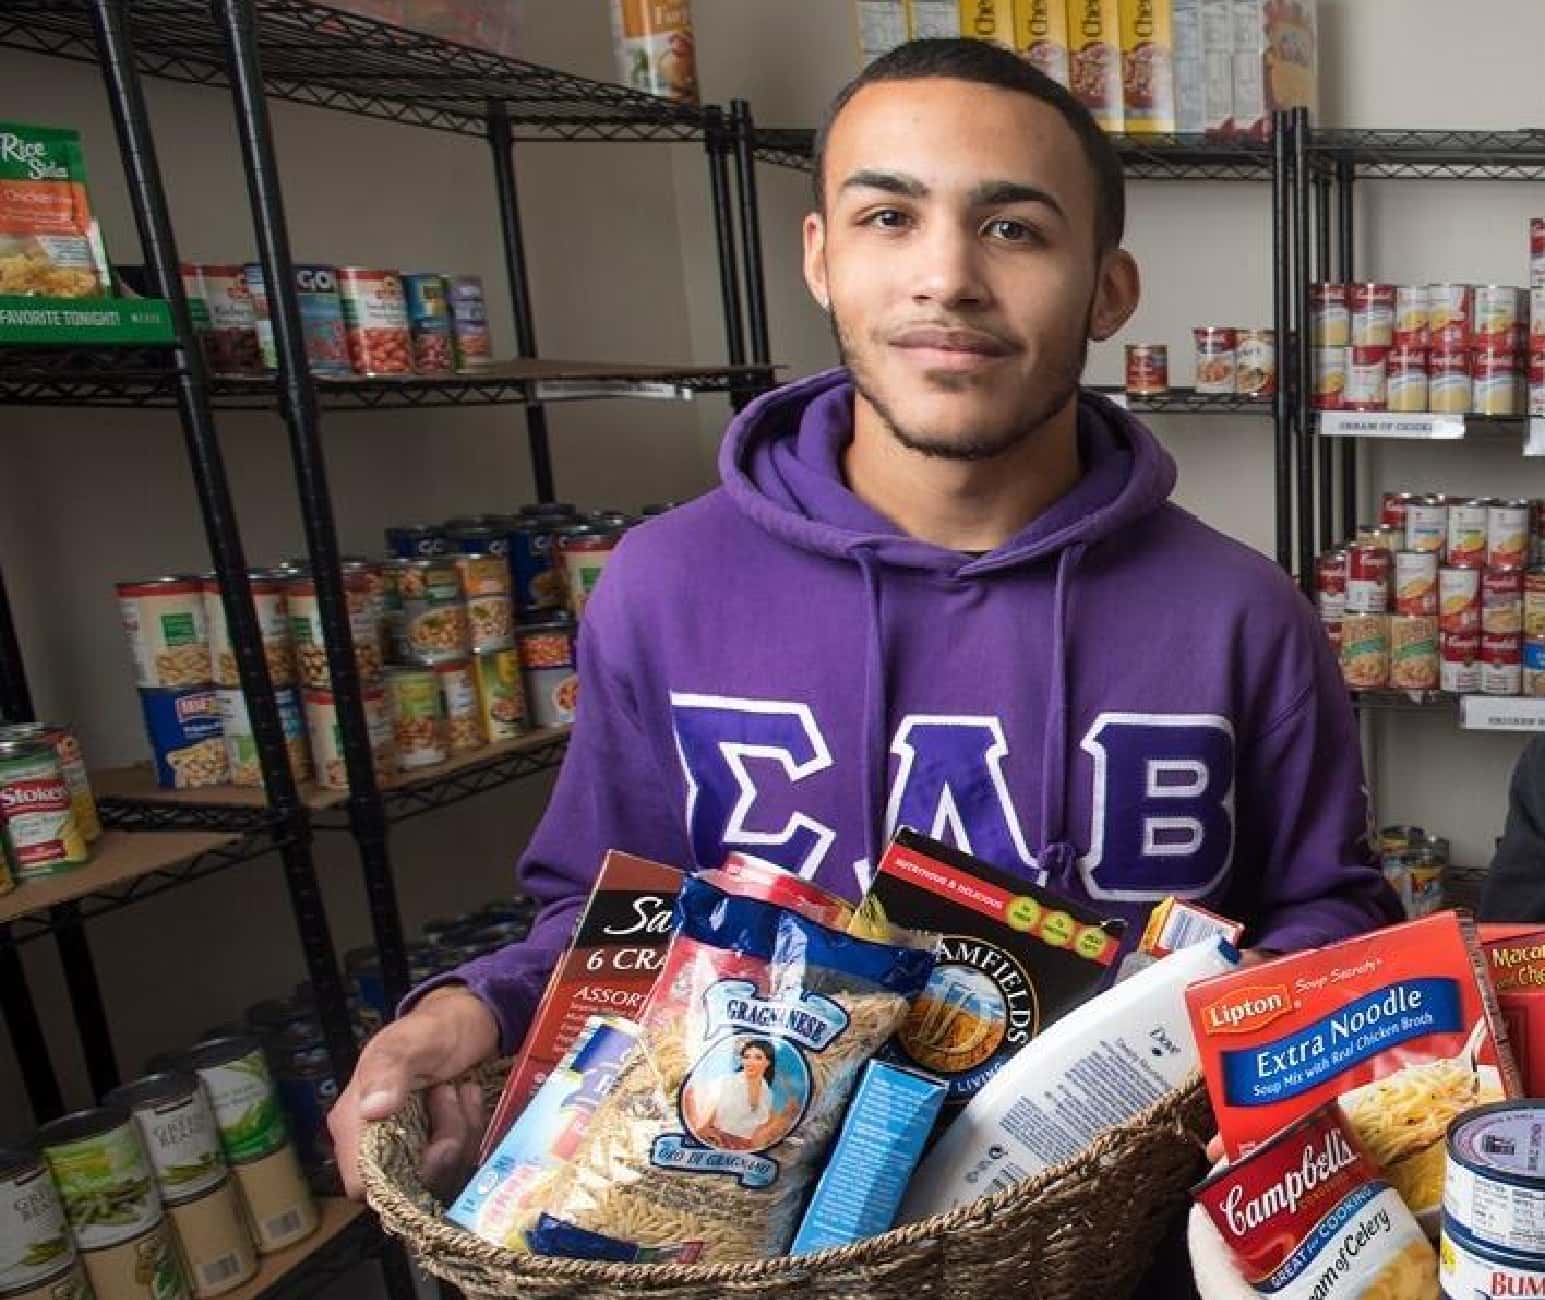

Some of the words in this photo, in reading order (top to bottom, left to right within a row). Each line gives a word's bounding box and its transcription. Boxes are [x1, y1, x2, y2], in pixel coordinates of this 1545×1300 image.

[0, 132, 48, 163] Rice
[587, 951, 602, 970] 6
[1209, 993, 1284, 1029] Lipton
[1257, 1034, 1326, 1079] Extra
[1330, 985, 1424, 1044] Noodle
[1254, 1079, 1282, 1099] Soup
[1285, 1073, 1303, 1089] Mix
[1305, 1060, 1330, 1081] with
[1332, 1046, 1355, 1065] Real
[1357, 1026, 1400, 1054] Chicken
[1402, 1013, 1434, 1034] Broth
[1219, 1127, 1362, 1237] Campbell's
[1342, 1207, 1391, 1257] Celery
[1335, 1248, 1351, 1272] of
